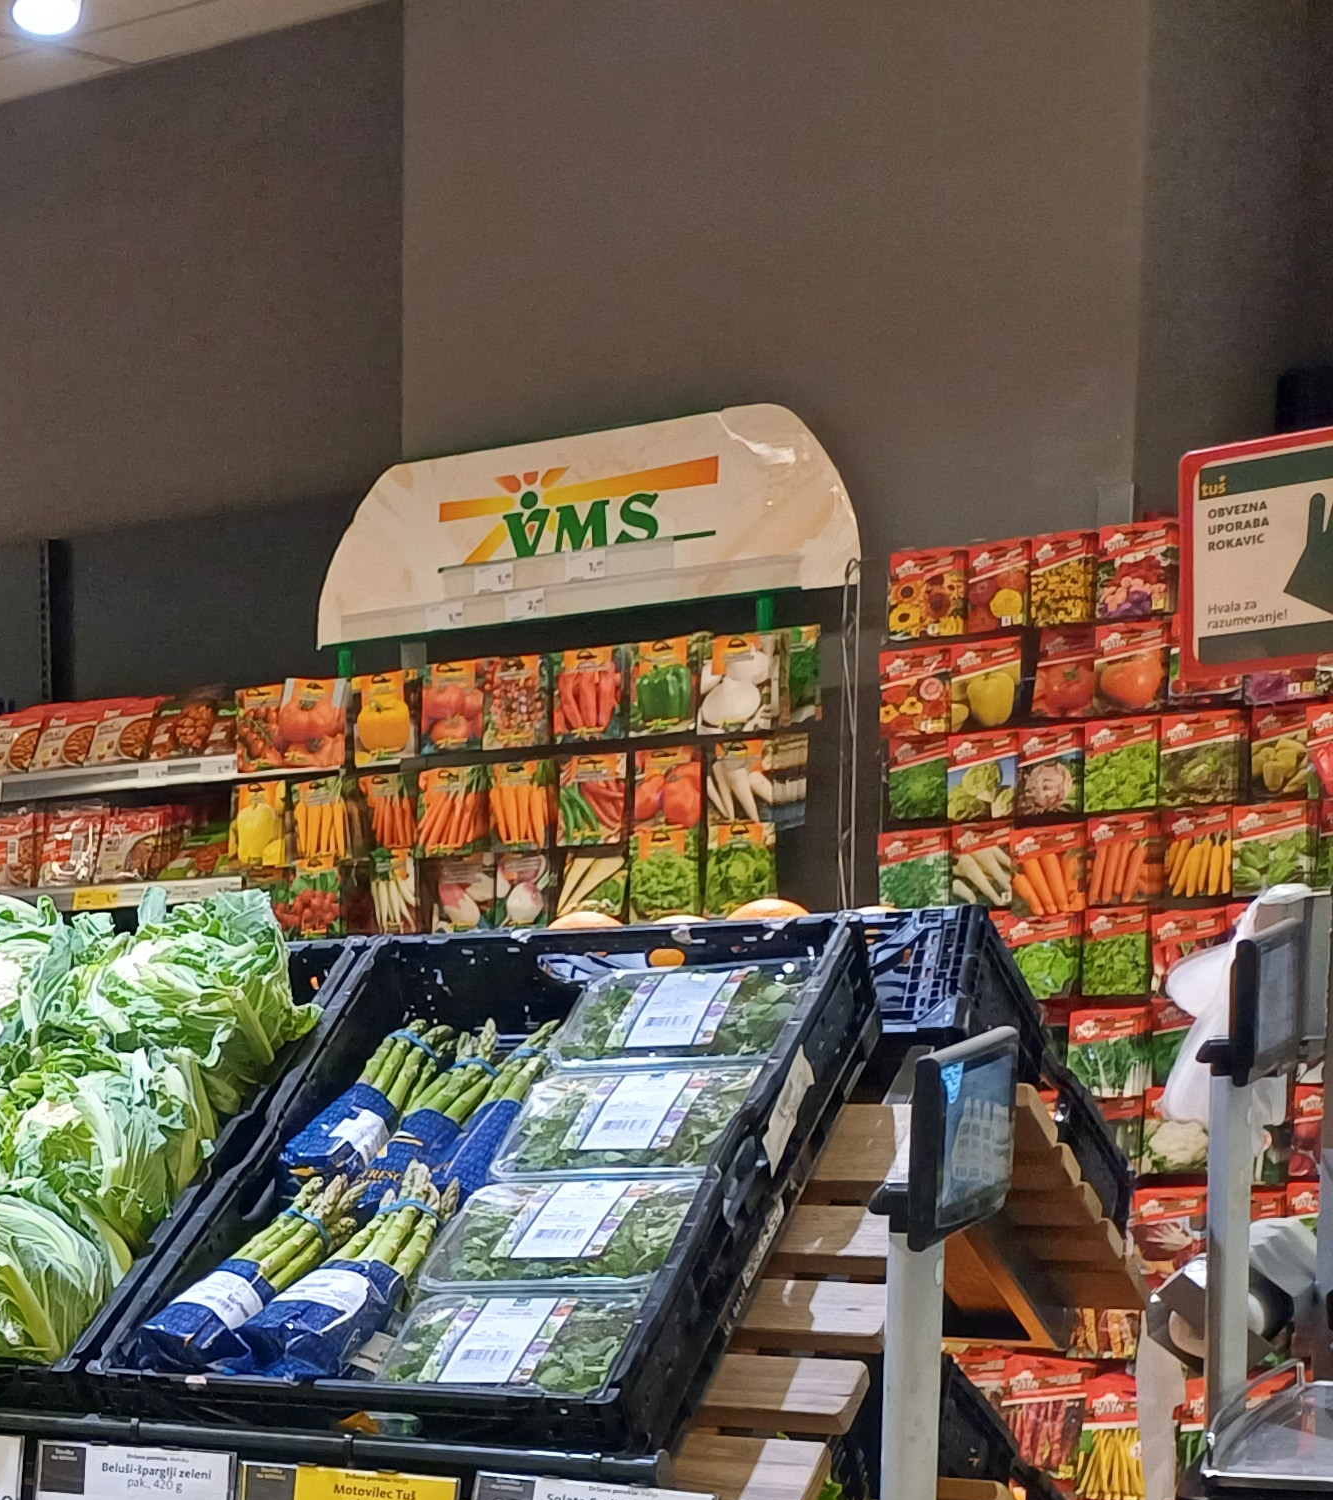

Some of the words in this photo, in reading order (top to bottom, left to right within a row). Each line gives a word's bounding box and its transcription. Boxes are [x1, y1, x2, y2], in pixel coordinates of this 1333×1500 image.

[1201, 475, 1227, 497] tuš
[1207, 501, 1268, 519] OBVEZNA
[503, 493, 659, 558] VMS
[1207, 517, 1270, 535] UPORABA
[1207, 533, 1265, 552] ROKAVIC
[1207, 601, 1241, 616] Hvala
[1244, 601, 1257, 611] za
[1207, 608, 1288, 630] razumevanje!
[102, 1462, 176, 1483] Beluši-šparglji
[178, 1468, 212, 1480] zeleni
[153, 1478, 173, 1490] 420
[176, 1482, 183, 1494] g
[333, 1483, 393, 1500] Motovilec
[395, 1489, 416, 1500] Tuš
